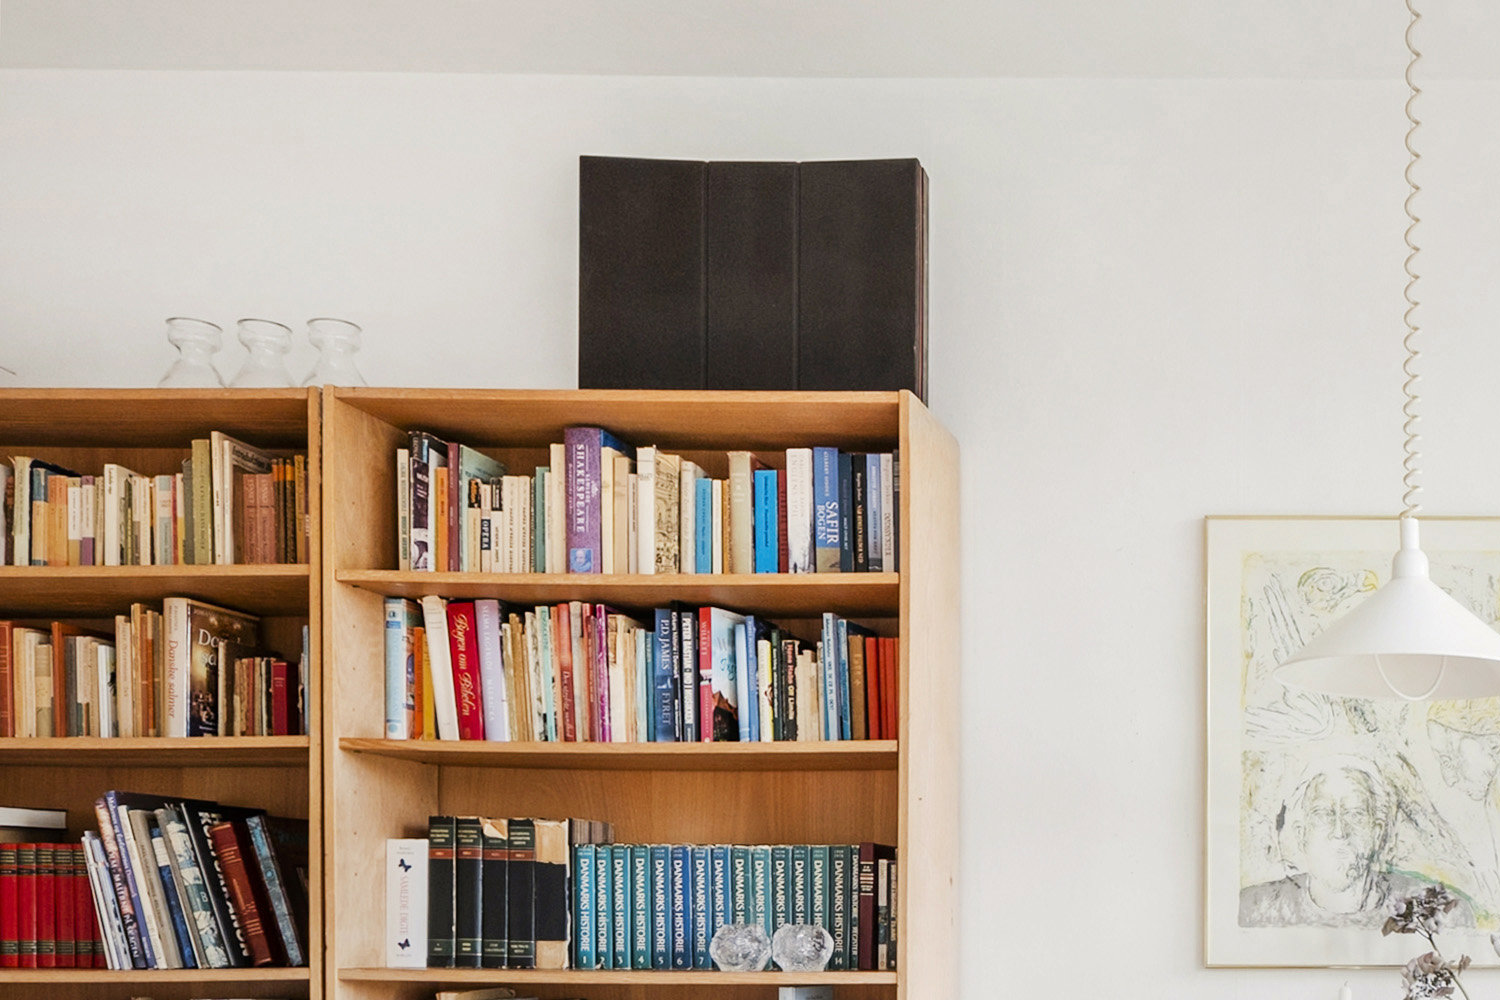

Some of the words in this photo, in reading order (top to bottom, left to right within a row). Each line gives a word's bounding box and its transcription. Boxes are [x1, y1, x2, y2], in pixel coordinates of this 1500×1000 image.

[577, 444, 585, 533] SHAKESPEARE
[817, 505, 826, 540] BOGEN
[825, 501, 839, 544] SAFIR
[452, 614, 470, 651] Bogen
[661, 619, 670, 636] P.D.
[167, 639, 178, 679] Danske
[458, 654, 468, 669] om
[658, 638, 671, 670] JAMES
[167, 682, 178, 719] salmer
[458, 672, 476, 717] Bibelen
[664, 692, 672, 725] FYRET
[399, 875, 409, 910] SAMLEDE
[580, 858, 590, 910] DANMARKS
[597, 859, 607, 911] DANMARKS
[615, 859, 624, 910] DANMARKS
[636, 858, 645, 909] DANMARKS
[655, 859, 665, 911] DANMARKS
[674, 860, 683, 911] DANMARKS
[696, 860, 706, 911] DANMARKS
[715, 860, 724, 911] DANMARKS
[735, 859, 744, 910] DANMARKS
[755, 860, 764, 912] DANMARKS
[776, 860, 785, 911] DANMARKS
[795, 860, 804, 911] DANMARKS
[814, 860, 824, 911] DANMARKS
[834, 860, 844, 911] DANMARKS
[851, 854, 859, 890] DANMARKS
[399, 912, 409, 936] DIGTE
[580, 911, 590, 951] HISTORIE
[597, 912, 607, 952] HISTORIE
[615, 911, 624, 952] HISTORIE
[636, 910, 645, 951] HISTORIE
[655, 912, 665, 953] HISTORIE
[674, 912, 683, 953] HISTORIE
[696, 912, 706, 952] HISTORIE
[834, 913, 844, 953] HISTORIE
